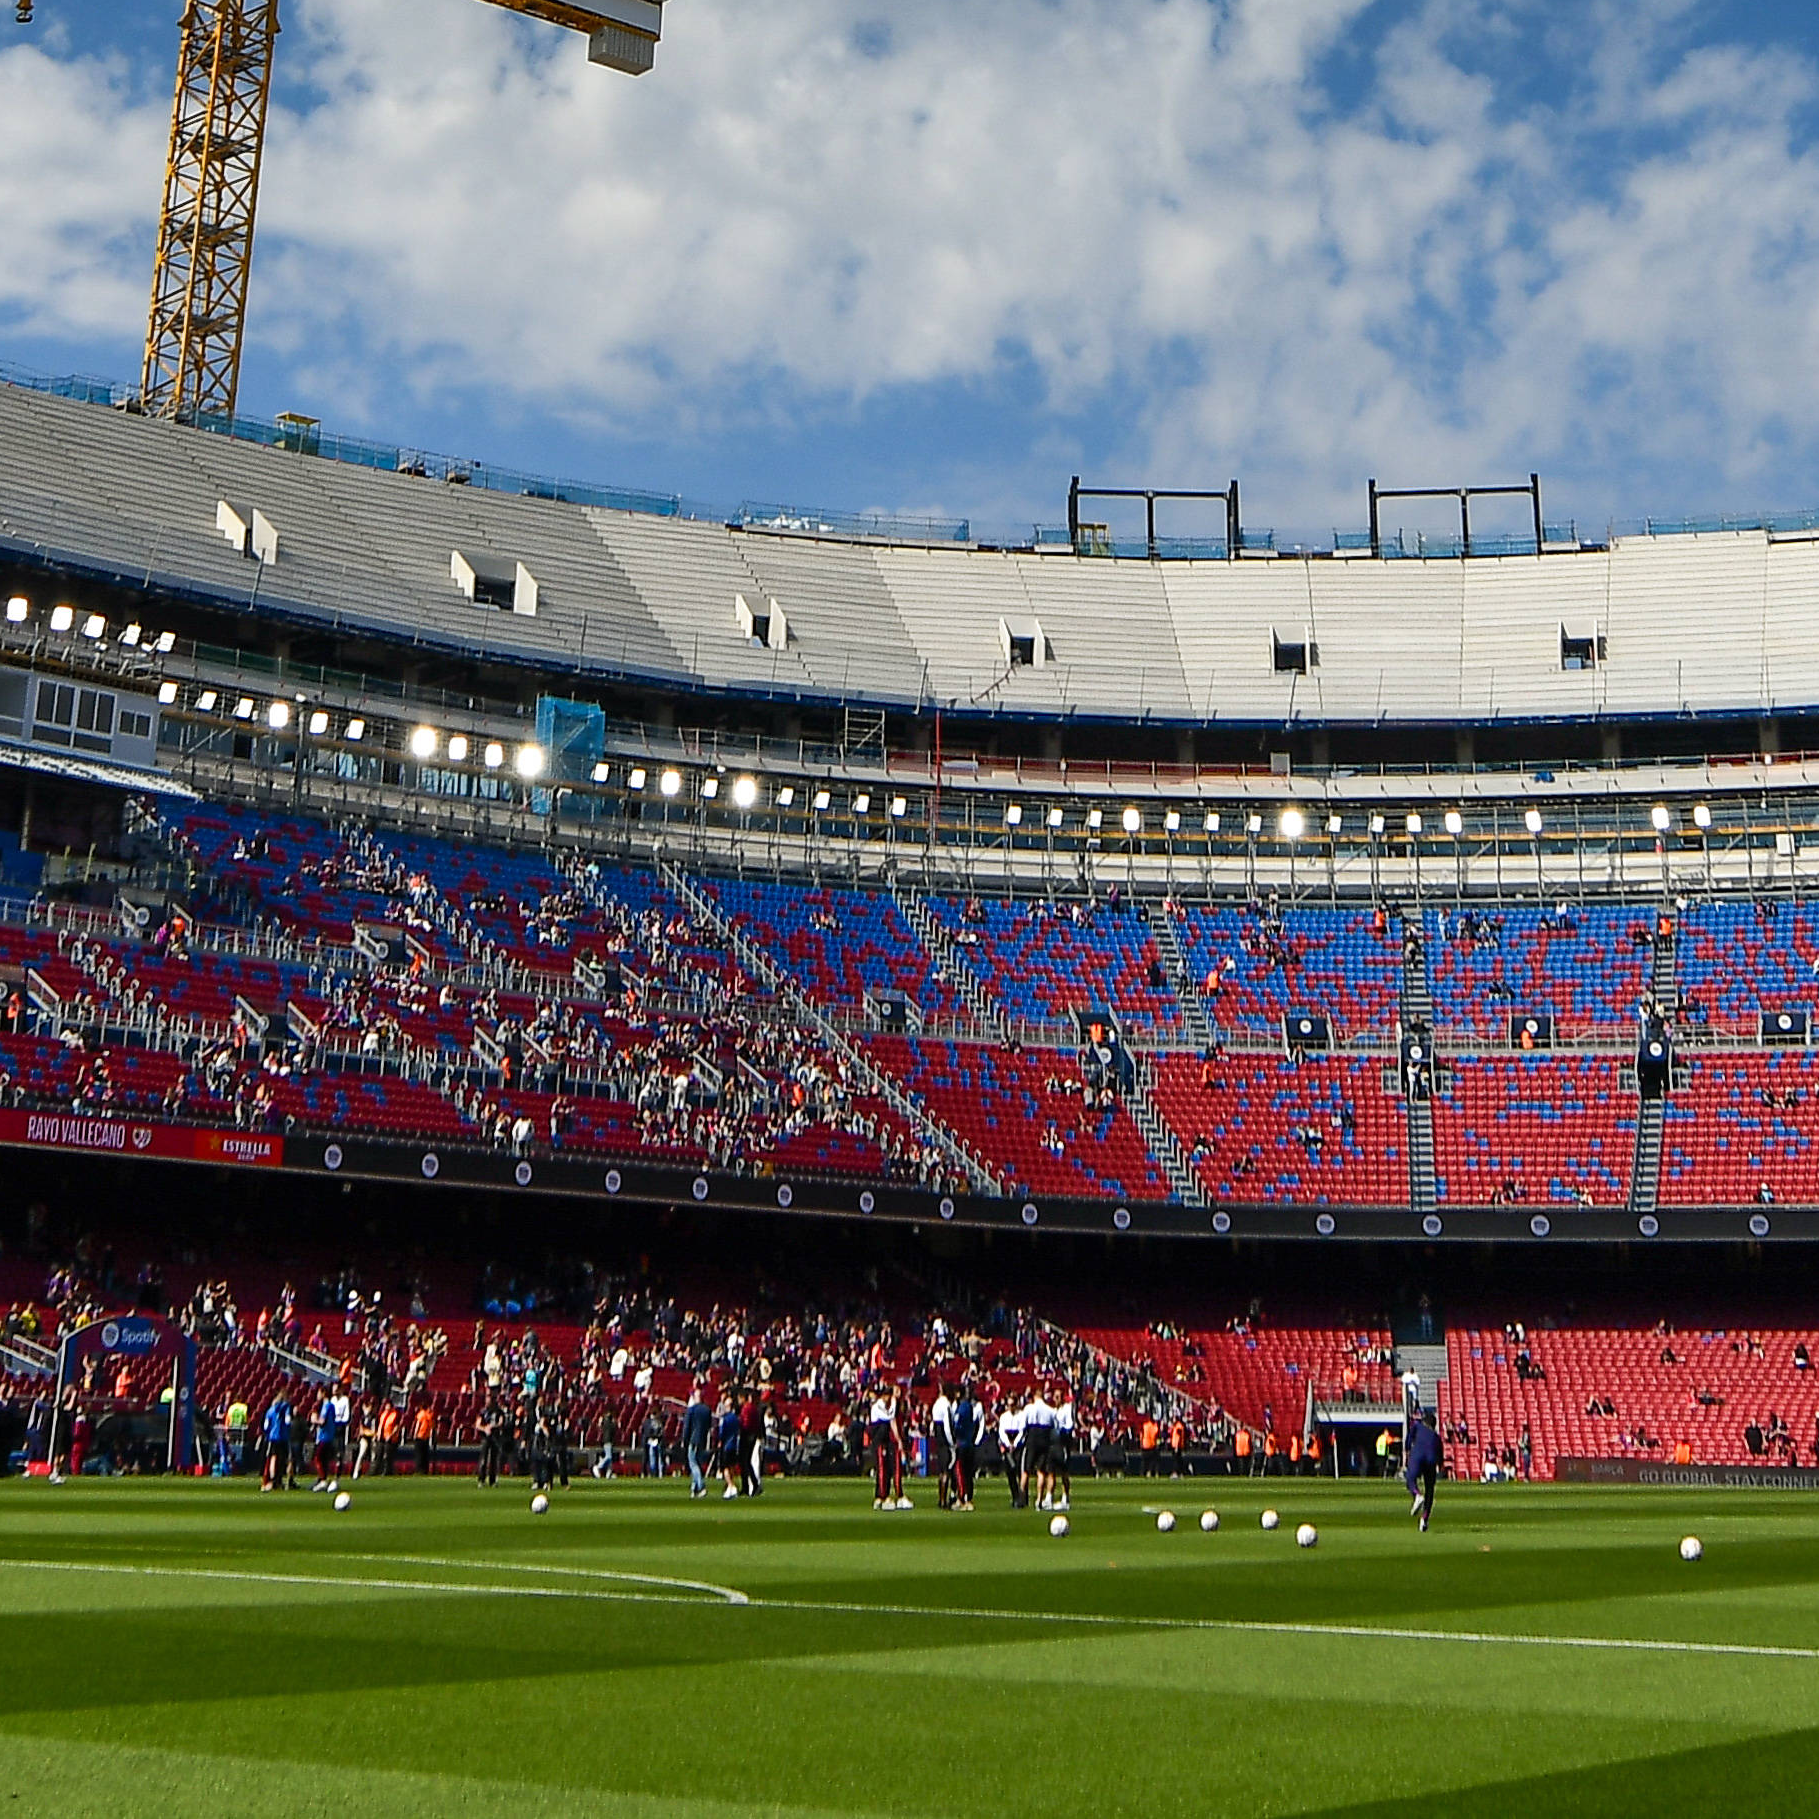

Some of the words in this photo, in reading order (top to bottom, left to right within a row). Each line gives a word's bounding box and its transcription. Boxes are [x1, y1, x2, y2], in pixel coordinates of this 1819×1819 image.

[27, 1115, 60, 1142] RAYO
[61, 1118, 126, 1149] VALLECANO
[223, 1139, 271, 1155] ESTRELLA
[120, 1327, 162, 1347] Spotify
